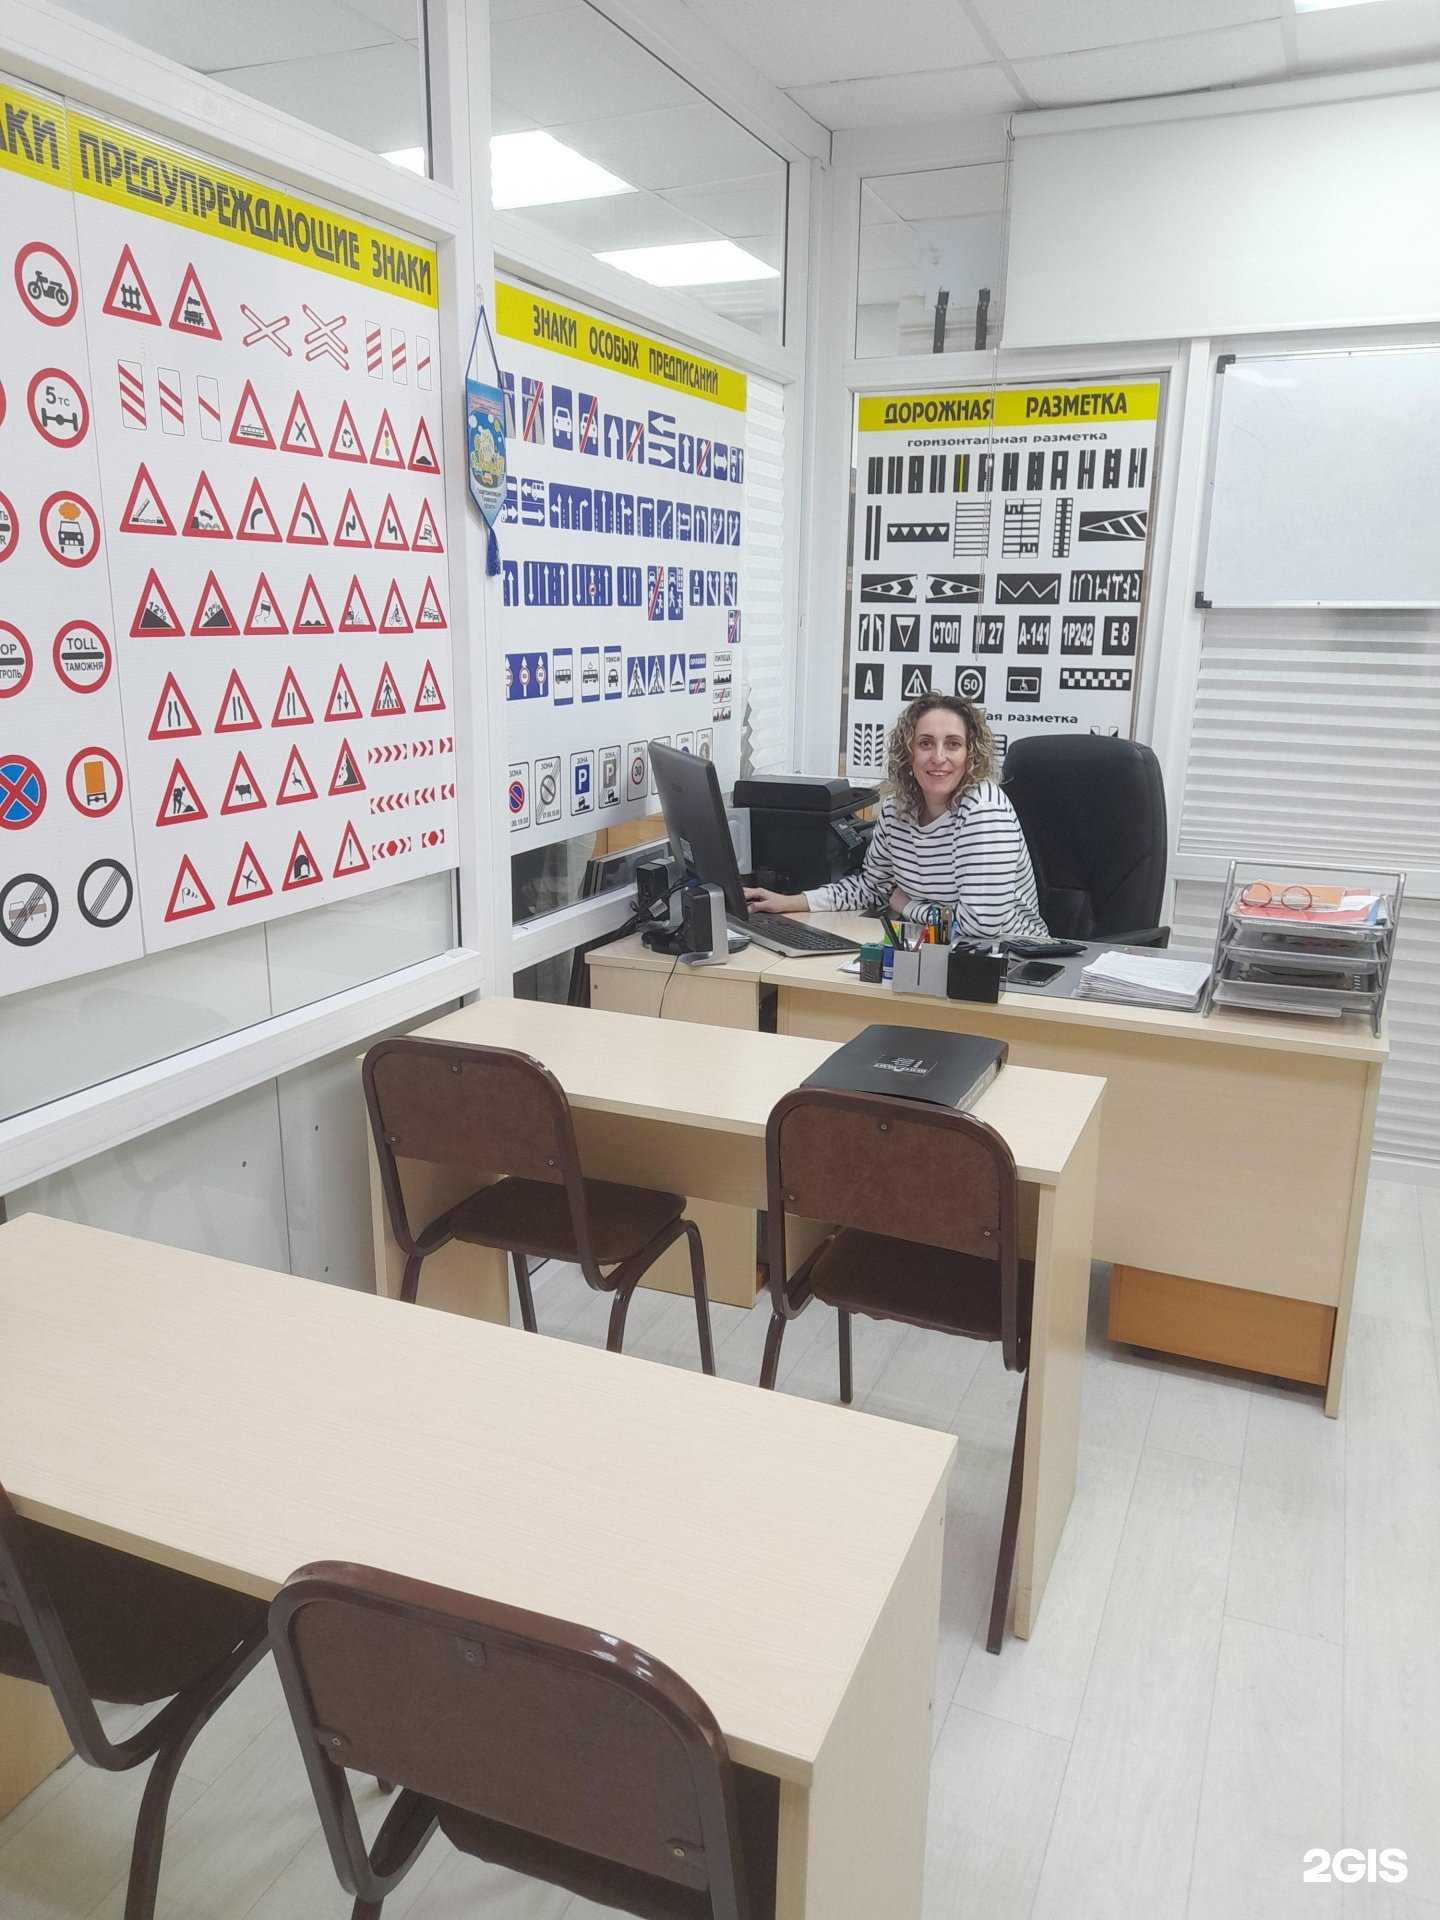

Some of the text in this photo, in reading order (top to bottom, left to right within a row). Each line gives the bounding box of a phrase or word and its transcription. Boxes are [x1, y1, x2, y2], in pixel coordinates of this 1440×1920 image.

[78, 132, 431, 296] ПРЕДУПРЕЖДАЮЩИЕ ЗНАКИ
[533, 304, 719, 396] ЗНАКИ ОСОБЫХ ПРЕДПИСАНИЙ
[45, 386, 57, 404] 5
[884, 392, 1128, 423] ДОРОЖНАЯ РАЗМЕТКА
[1033, 432, 1108, 443] разметка
[66, 638, 97, 650] TOLL
[932, 621, 960, 645] СТОП
[988, 621, 1004, 645] 27
[1018, 621, 1050, 646] А-141
[1120, 622, 1130, 646] 8
[65, 662, 103, 671] ТАМОЖНЯ
[963, 678, 979, 693] 50
[1008, 713, 1078, 724] разметка
